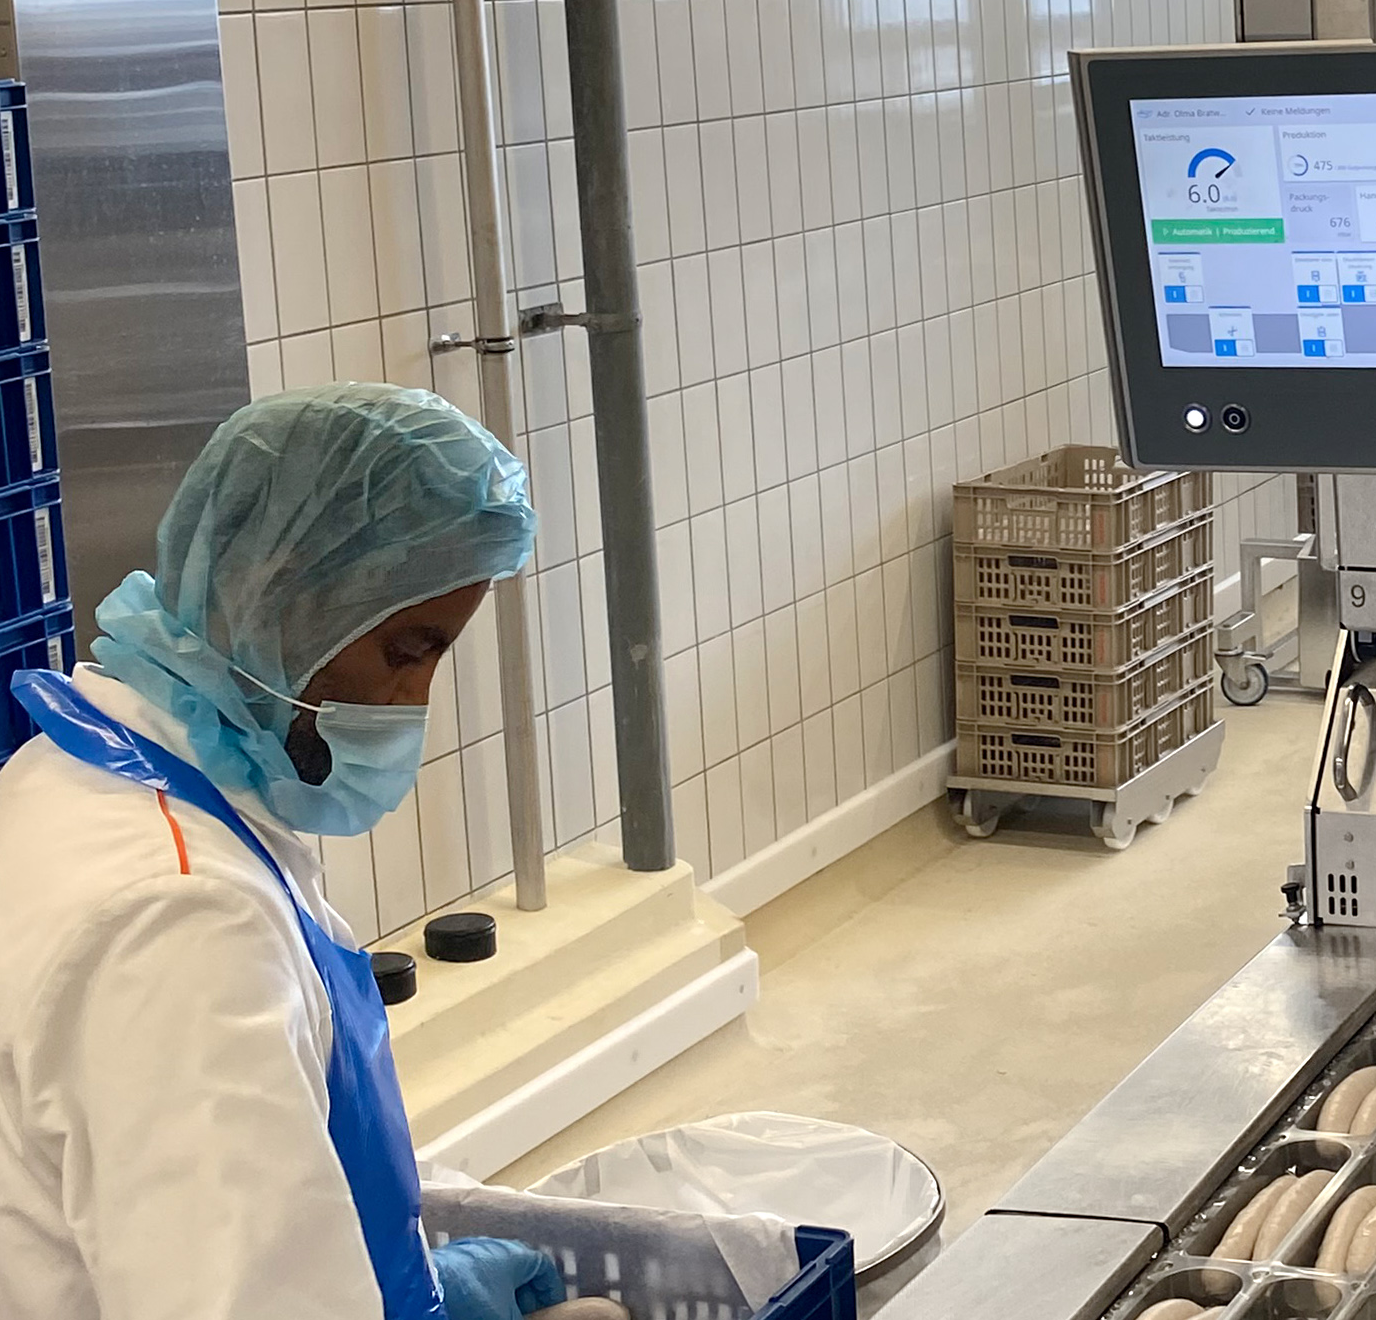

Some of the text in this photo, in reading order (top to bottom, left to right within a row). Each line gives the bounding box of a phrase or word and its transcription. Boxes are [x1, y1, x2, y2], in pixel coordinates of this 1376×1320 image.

[1261, 107, 1331, 117] Keine Meldungen
[1143, 133, 1191, 143] Taktleistung
[1282, 130, 1327, 139] Produktion
[1313, 160, 1333, 171] 475
[1188, 184, 1221, 203] 6.0
[1289, 192, 1330, 203] Packungs-
[1290, 204, 1313, 213] druck
[1329, 216, 1351, 228] 676
[1172, 226, 1276, 236] Automatik Produzierend
[1350, 584, 1366, 608] 9
